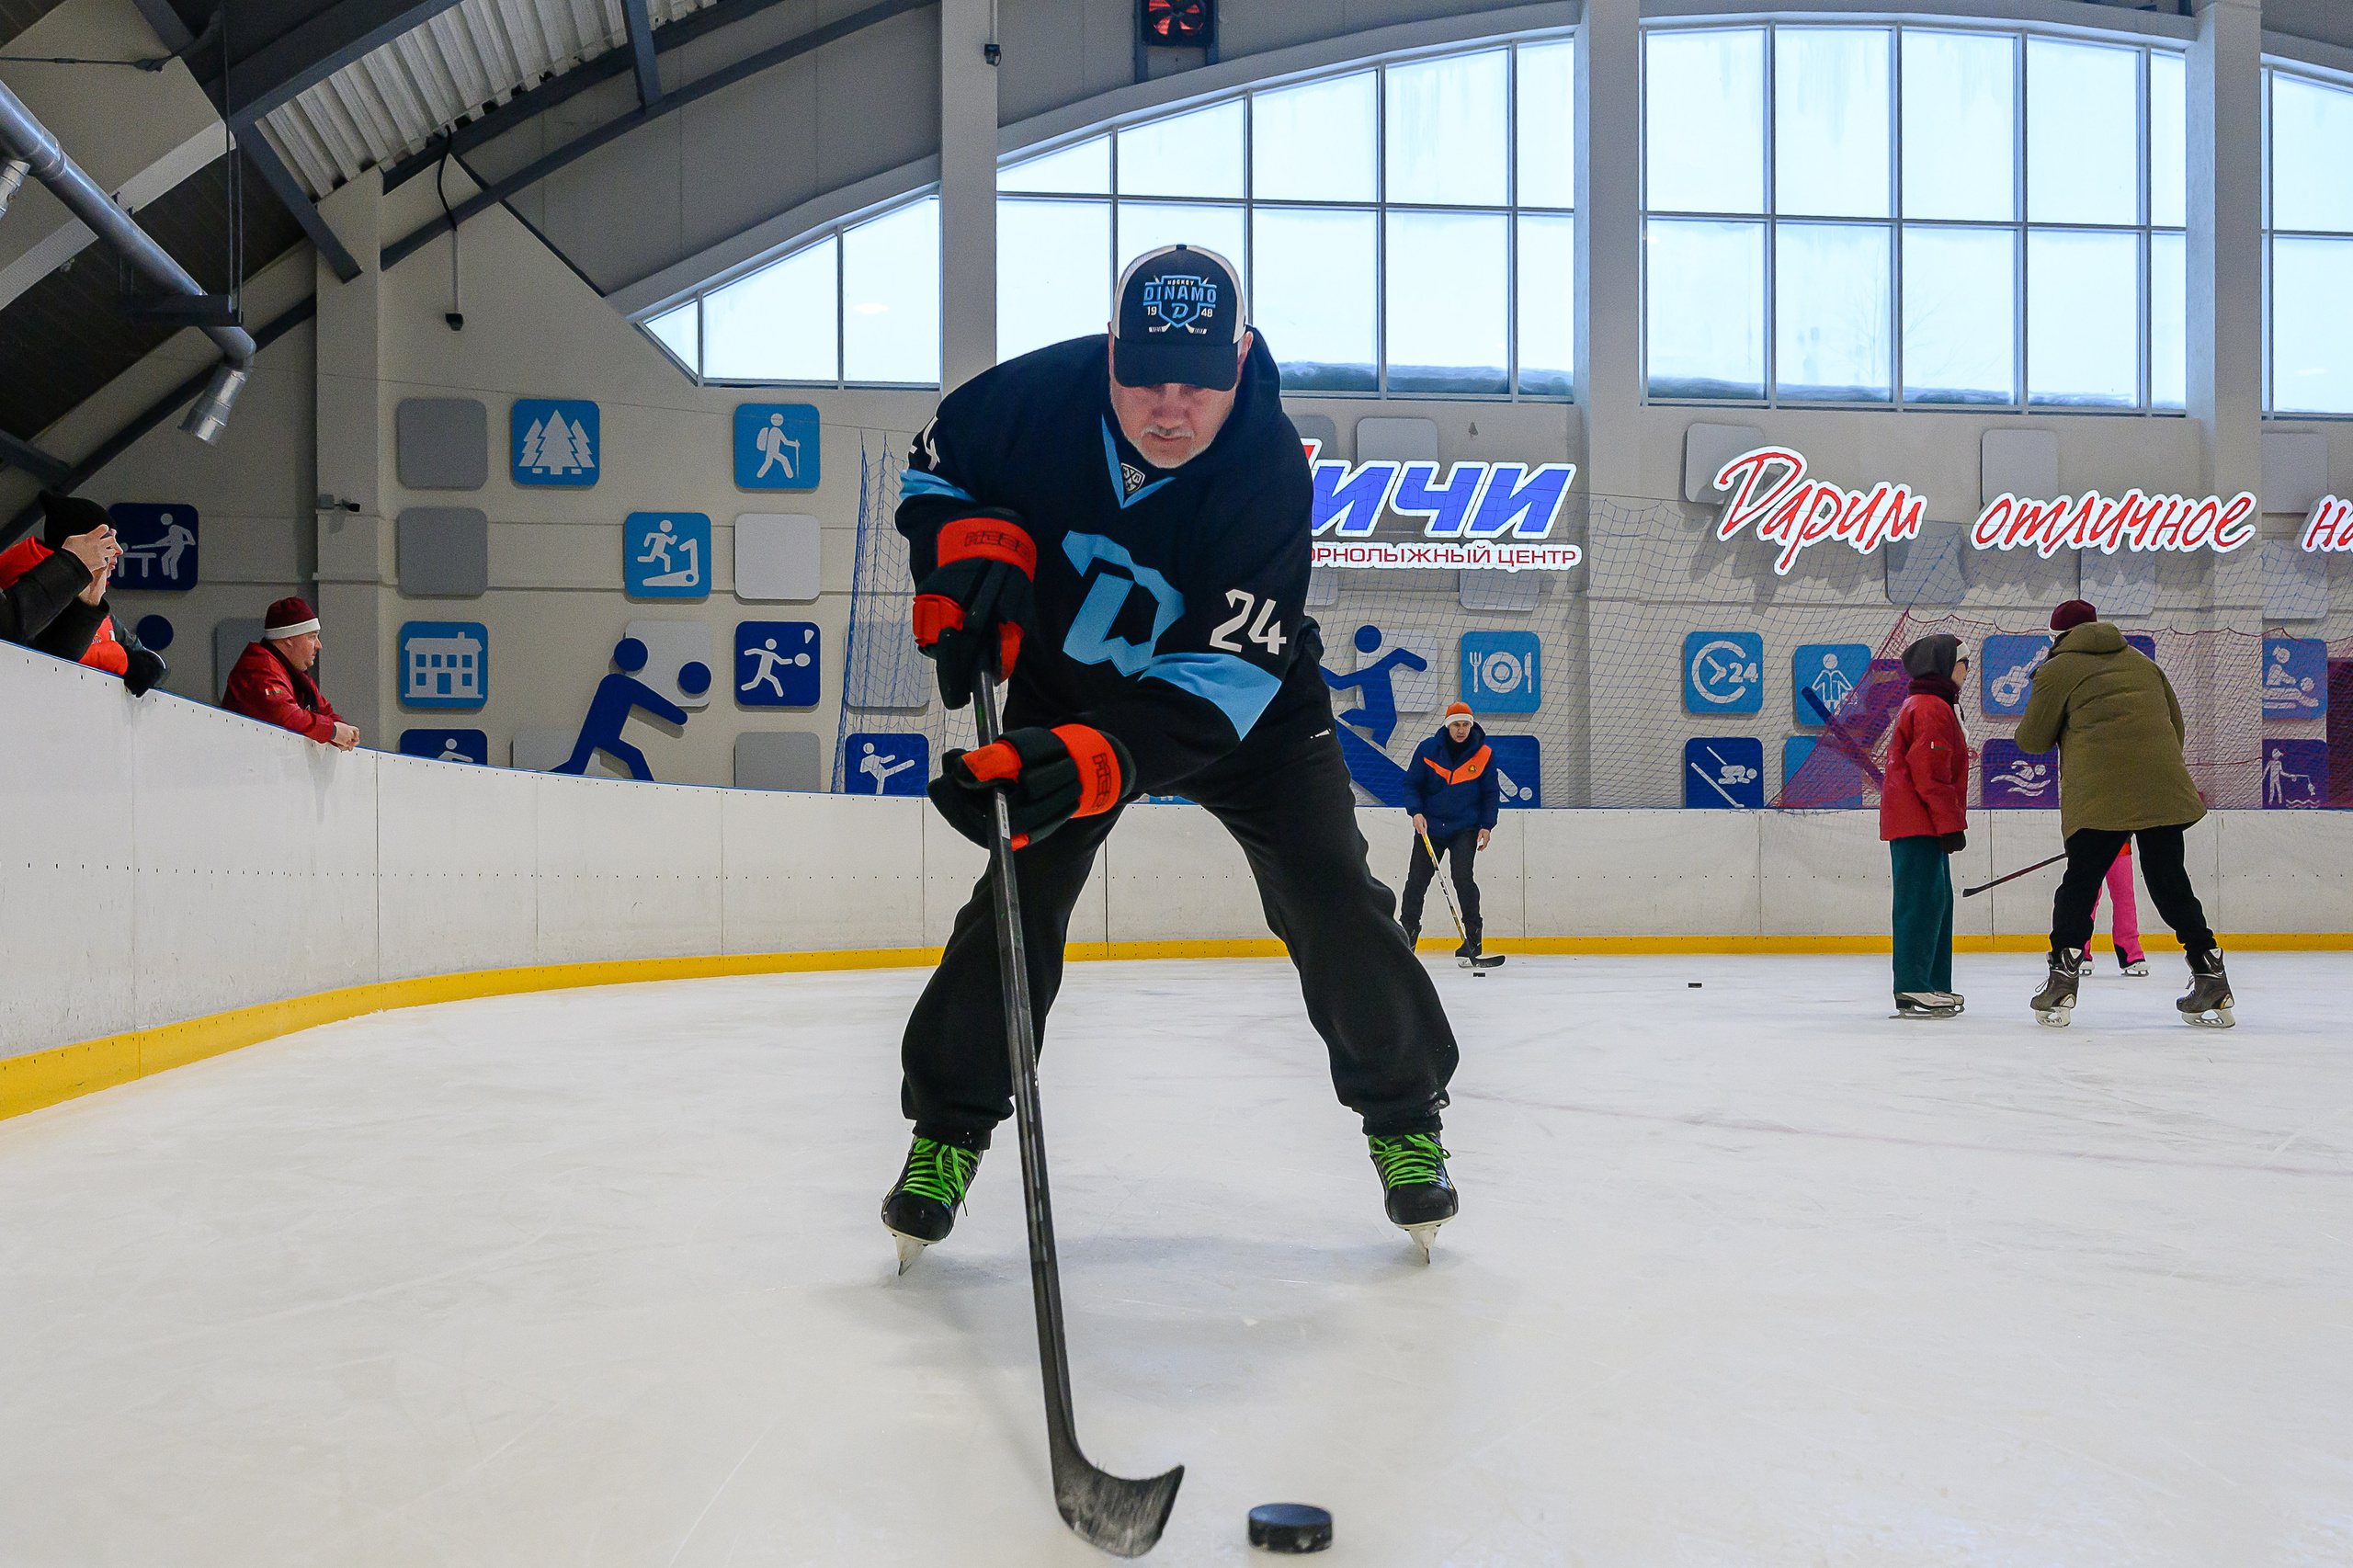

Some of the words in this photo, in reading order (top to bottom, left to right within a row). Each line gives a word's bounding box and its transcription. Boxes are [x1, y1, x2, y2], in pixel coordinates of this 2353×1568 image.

[1143, 285, 1217, 303] DINAMO
[1147, 306, 1157, 316] 19
[1200, 307, 1213, 318] 48
[1302, 441, 1574, 536] ИЧИ
[1716, 449, 1925, 573] Дарим
[1973, 492, 2255, 556] отличное
[1498, 549, 1576, 567] ЦЕНТР
[1210, 588, 1287, 655] 24
[1729, 662, 1758, 683] 24
